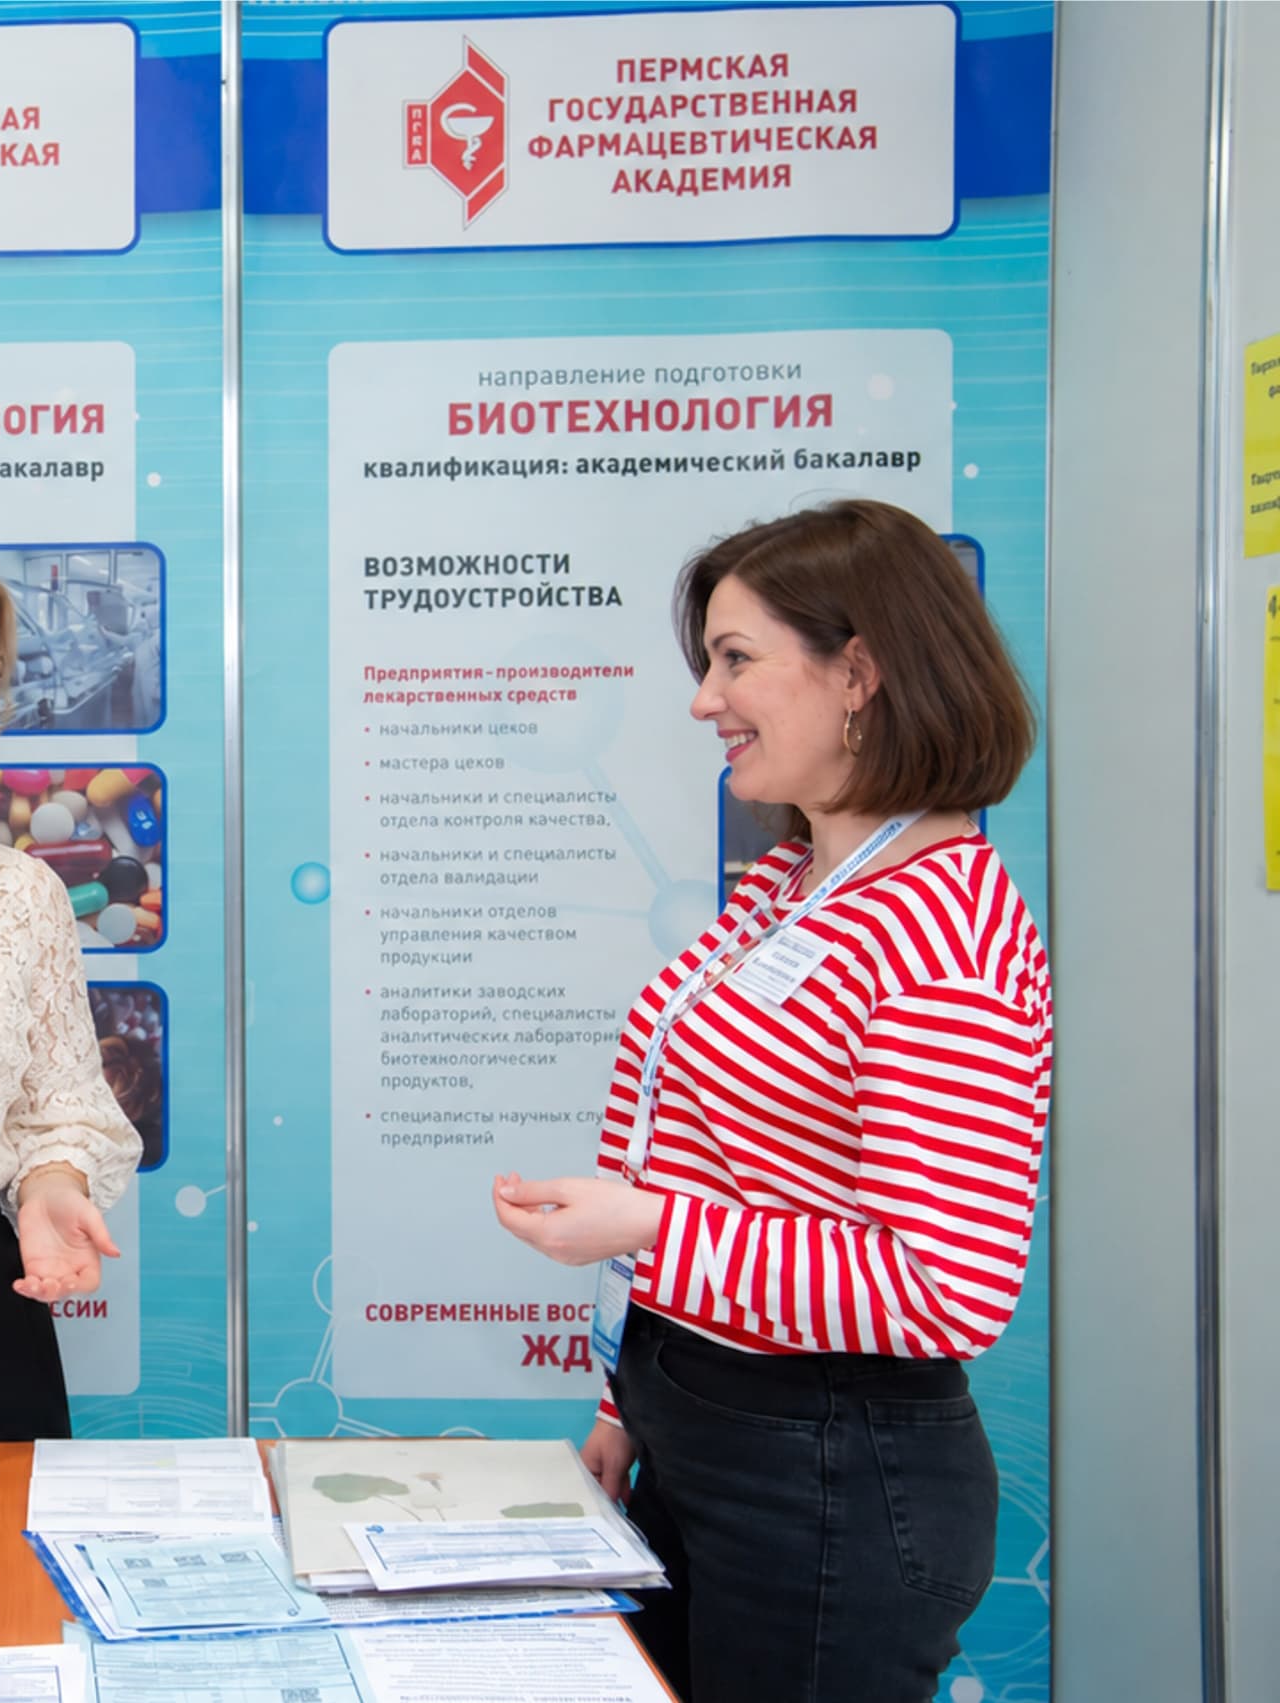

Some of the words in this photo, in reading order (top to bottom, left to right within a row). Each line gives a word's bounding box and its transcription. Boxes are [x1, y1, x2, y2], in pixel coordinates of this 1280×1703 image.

[617, 54, 788, 83] ПЕРМСКАЯ
[549, 89, 856, 124] ГОСУДАРСТВЕННАЯ
[528, 126, 877, 160] ФАРМАЦЕВТИЧЕСКАЯ
[612, 164, 790, 196] АКАДЕМИЯ
[479, 368, 645, 390] направление
[655, 364, 801, 387] подготовки
[449, 394, 832, 435] БИОТЕХНОЛОГИЯ
[364, 456, 568, 481] квалификация:
[576, 449, 784, 476] академический
[794, 449, 921, 472] бакалавр
[365, 554, 569, 577] ВОЗМОЖНОСТИ
[364, 582, 622, 613] ТРУДОУСТРОЙСТВА
[364, 691, 502, 706] лекарственных
[380, 723, 483, 736] начальники
[380, 758, 449, 773] мастера
[380, 793, 483, 805] начальники
[488, 792, 498, 803] и
[504, 791, 617, 804] специалисты
[380, 816, 439, 829] отдела
[444, 815, 523, 830] контроля
[529, 814, 610, 827] качества,
[380, 850, 483, 862] начальники
[488, 850, 498, 862] и
[504, 848, 616, 862] специалисты
[380, 873, 438, 886] отдела
[445, 872, 538, 885] валидации
[380, 907, 483, 919] начальники
[488, 906, 557, 920] отделов
[380, 930, 482, 945] управления
[488, 929, 576, 941] качеством
[381, 952, 472, 967] продукции
[380, 987, 472, 999] аналитики
[478, 987, 565, 1000] заводских
[381, 1006, 496, 1024] лабораторий,
[502, 1009, 616, 1022] специалисты
[380, 1032, 510, 1043] аналитических
[381, 1051, 557, 1065] биотехнологических
[381, 1076, 473, 1090] продуктов,
[380, 1111, 494, 1124] специалисты
[499, 1112, 571, 1126] научных
[576, 1109, 604, 1125] слу
[381, 1131, 494, 1148] предприятий
[50, 1300, 108, 1318] ССИИ
[366, 1304, 540, 1322] СОВРЕМЕННЫЕ
[546, 1304, 595, 1322] ВОС
[522, 1334, 592, 1372] ЖД
